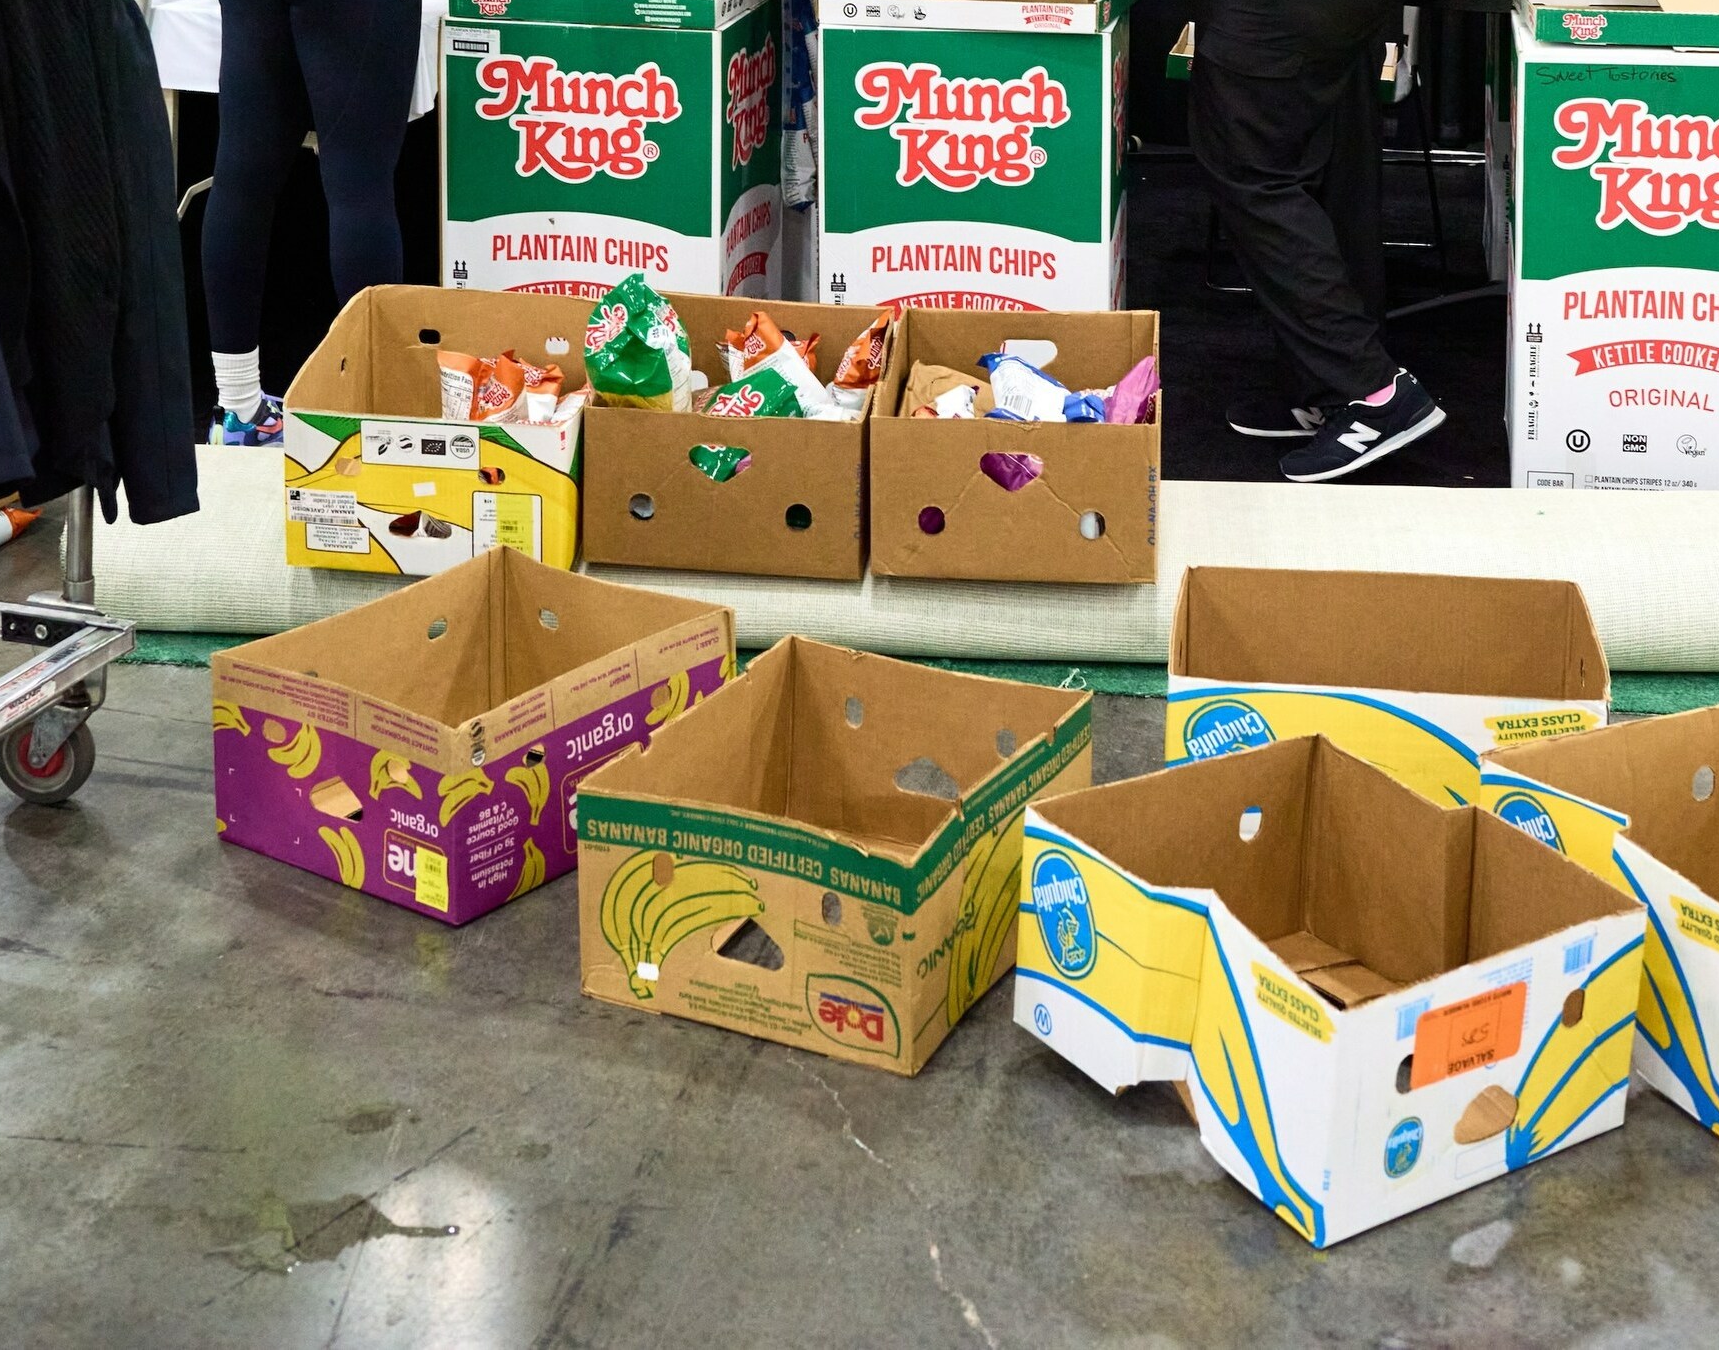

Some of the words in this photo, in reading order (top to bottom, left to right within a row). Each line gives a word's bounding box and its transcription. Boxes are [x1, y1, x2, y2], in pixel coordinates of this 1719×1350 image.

[479, 2, 507, 15] King
[1022, 4, 1053, 14] PLANTAIN
[1054, 6, 1074, 15] CHIPS
[1563, 14, 1606, 26] Munch
[1570, 25, 1601, 39] King
[728, 35, 775, 116] Munch
[1536, 66, 1595, 85] Sweet
[482, 60, 678, 120] Munch
[861, 67, 1067, 126] Munch
[732, 102, 769, 169] King
[515, 119, 647, 179] King
[896, 125, 1031, 188] King
[752, 201, 771, 233] CHIPS
[492, 234, 601, 262] PLANTAIN
[605, 238, 668, 272] CHIPS
[872, 244, 981, 273] PLANTAIN
[989, 246, 1056, 279] CHIPS
[518, 282, 576, 298] KETTLE
[898, 294, 956, 309] KETTLE
[1563, 290, 1684, 320] PLANTAIN
[1529, 345, 1537, 377] FRAGILE
[1592, 342, 1654, 368] KETTLE
[1609, 388, 1715, 413] ORIGINAL
[1527, 410, 1535, 440] FRAGIL
[1623, 444, 1647, 452] GMO
[1624, 435, 1646, 443] NON
[1552, 479, 1564, 487] BAR
[1594, 475, 1620, 484] PLANTAIN
[1621, 476, 1638, 485] CHIPS
[1640, 477, 1662, 486] STRIPES
[1682, 480, 1693, 488] 340
[292, 505, 325, 513] CAVENDISH
[1496, 715, 1538, 731] EXTRA
[1540, 713, 1581, 729] CLASS
[567, 711, 633, 761] organic
[1186, 711, 1265, 760] Chiquita
[1497, 729, 1538, 741] QUALITY
[1027, 753, 1061, 789] ORGANIC
[502, 801, 507, 810] C
[507, 808, 514, 818] of
[987, 778, 1026, 824] BANANAS
[390, 809, 438, 838] organic
[466, 828, 495, 844] Source
[468, 814, 505, 834] Vitamins
[498, 816, 519, 833] Good
[587, 819, 667, 845] BANANAS
[469, 848, 491, 863] Fiber
[494, 843, 502, 854] of
[672, 830, 743, 859] ORGANIC
[471, 857, 514, 882] Potassium
[747, 844, 822, 879] CERTIFIED
[478, 880, 486, 888] in
[488, 870, 507, 887] High
[830, 867, 900, 906] BANANAS
[916, 851, 953, 903] ORGANIC
[1033, 874, 1086, 913] Chiquita
[1681, 903, 1713, 926] EXTRA
[1681, 920, 1712, 942] QUALITY
[1260, 975, 1289, 1004] EXTRA
[1257, 993, 1287, 1018] QUALITY
[1290, 994, 1319, 1022] CLASS
[818, 1000, 884, 1042] Dole
[1289, 1014, 1322, 1039] SELECTED
[1446, 1049, 1495, 1075] SALVAGE
